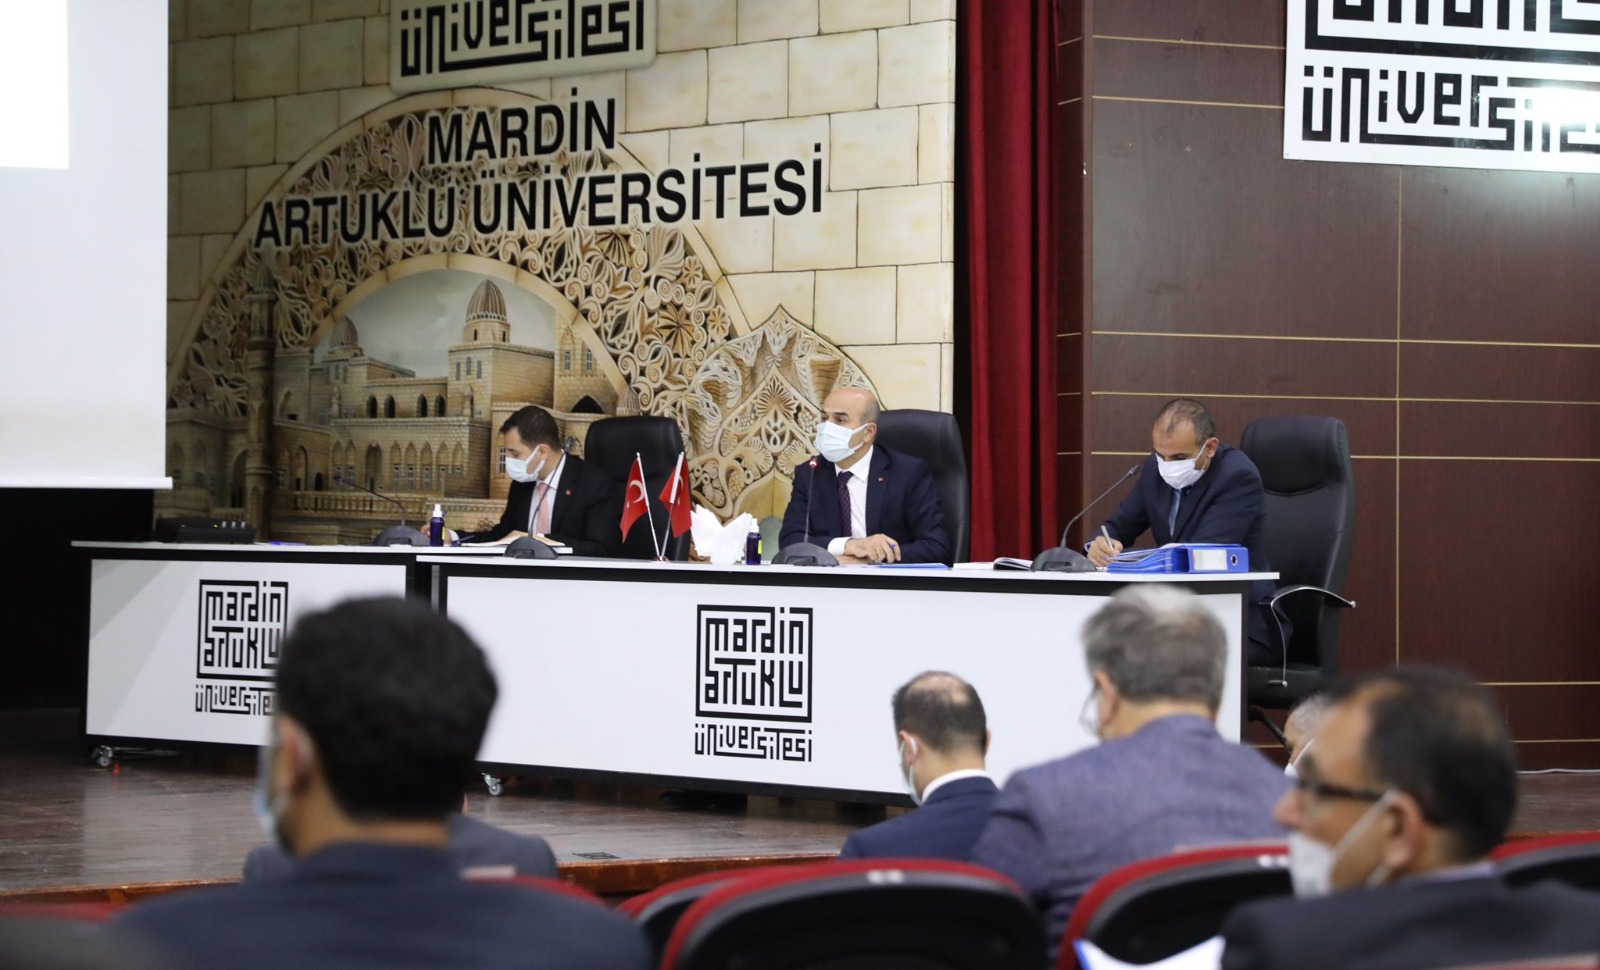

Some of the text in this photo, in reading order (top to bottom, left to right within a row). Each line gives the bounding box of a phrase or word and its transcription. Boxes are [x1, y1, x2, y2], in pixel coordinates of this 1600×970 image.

[427, 86, 616, 165] MARDİN
[253, 142, 822, 249] ARTUKLU ÜNİVERSİTESİ
[694, 723, 813, 763] üniversitesi
